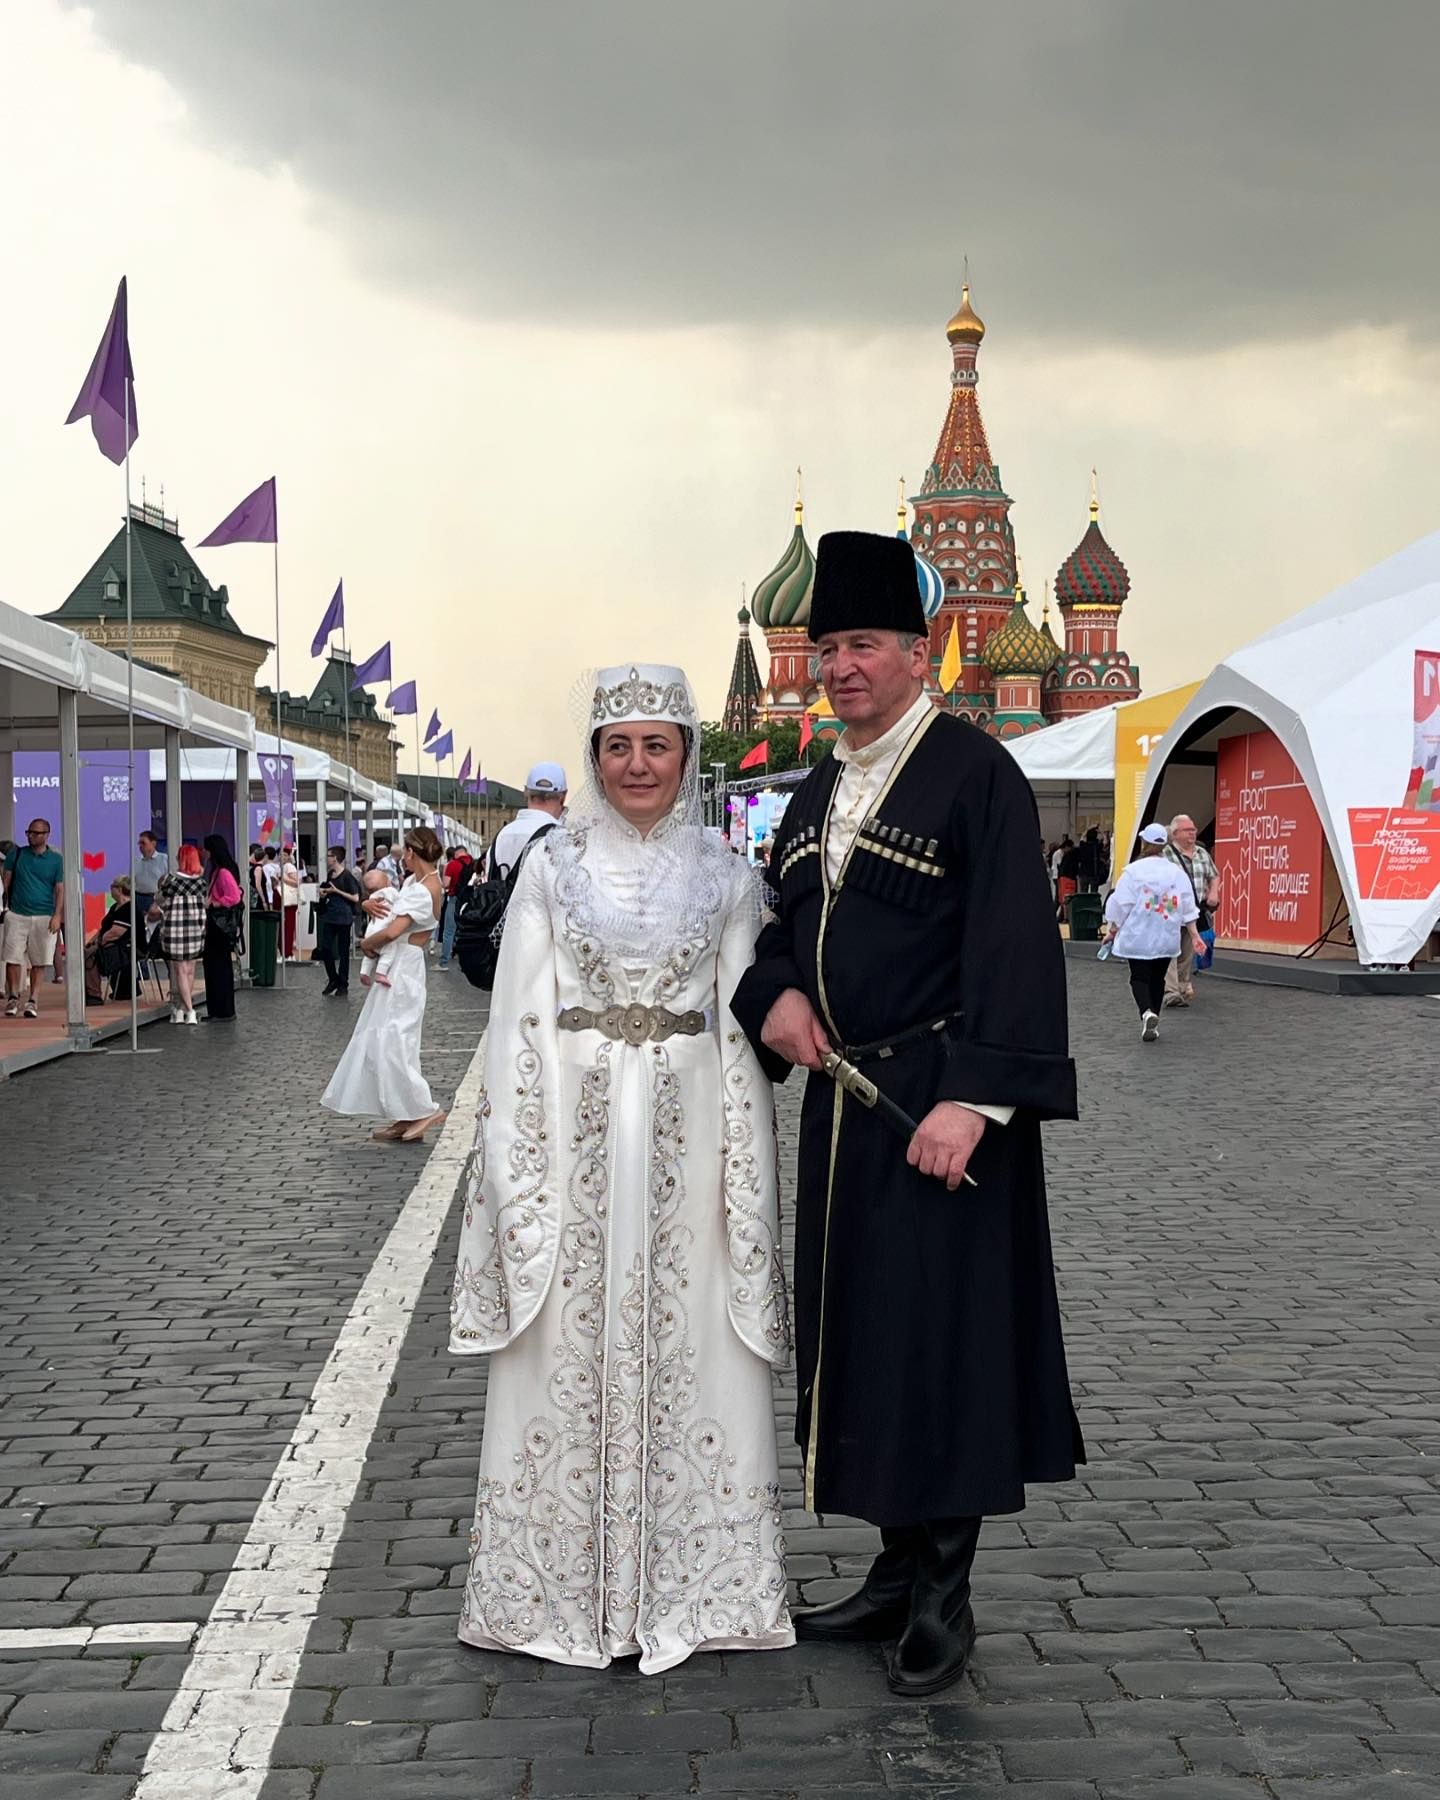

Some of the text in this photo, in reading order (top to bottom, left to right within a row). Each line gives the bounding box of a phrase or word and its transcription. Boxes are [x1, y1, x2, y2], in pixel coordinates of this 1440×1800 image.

[13, 776, 60, 788] ЕННАЯ
[1239, 788, 1267, 812] ПРОСТ
[1239, 815, 1279, 840] РАНСТВО
[1269, 873, 1310, 897] БУДУЩЕЕ
[1268, 901, 1298, 922] КНИГИ
